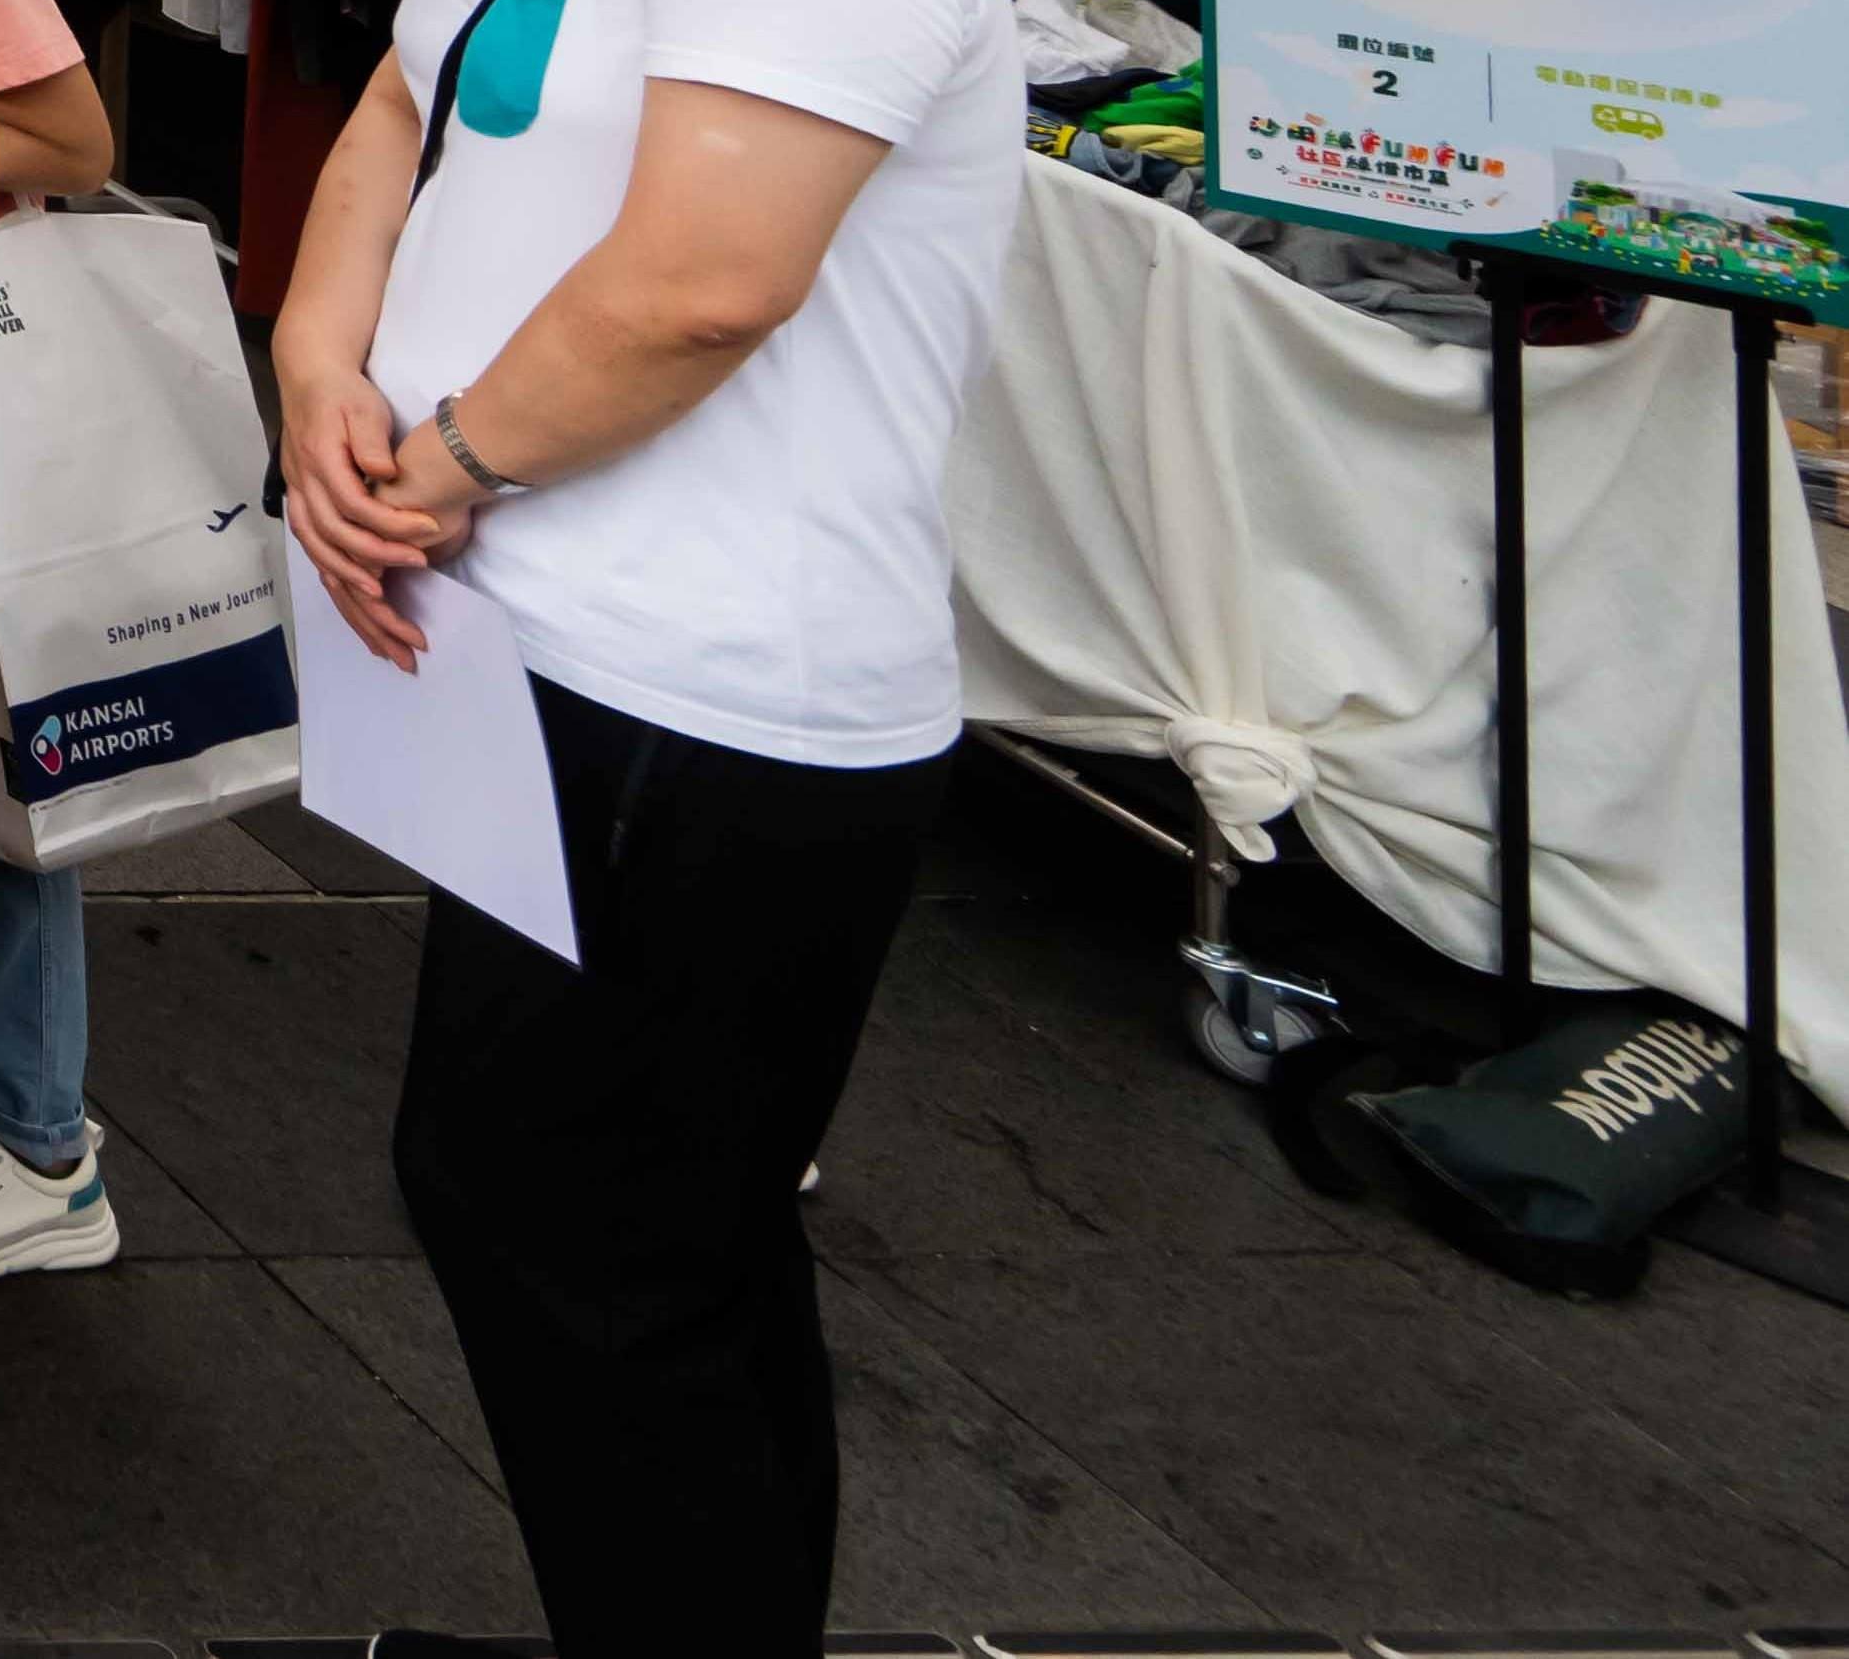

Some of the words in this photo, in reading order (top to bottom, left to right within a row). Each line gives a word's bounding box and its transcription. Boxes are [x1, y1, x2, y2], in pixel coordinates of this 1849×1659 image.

[1372, 69, 1400, 98] 2
[107, 614, 171, 645] Shaping
[177, 613, 184, 626] a
[189, 599, 221, 623] New
[225, 578, 275, 610] Journey
[65, 696, 145, 733] KANSAI
[69, 720, 175, 764] AIRPORTS
